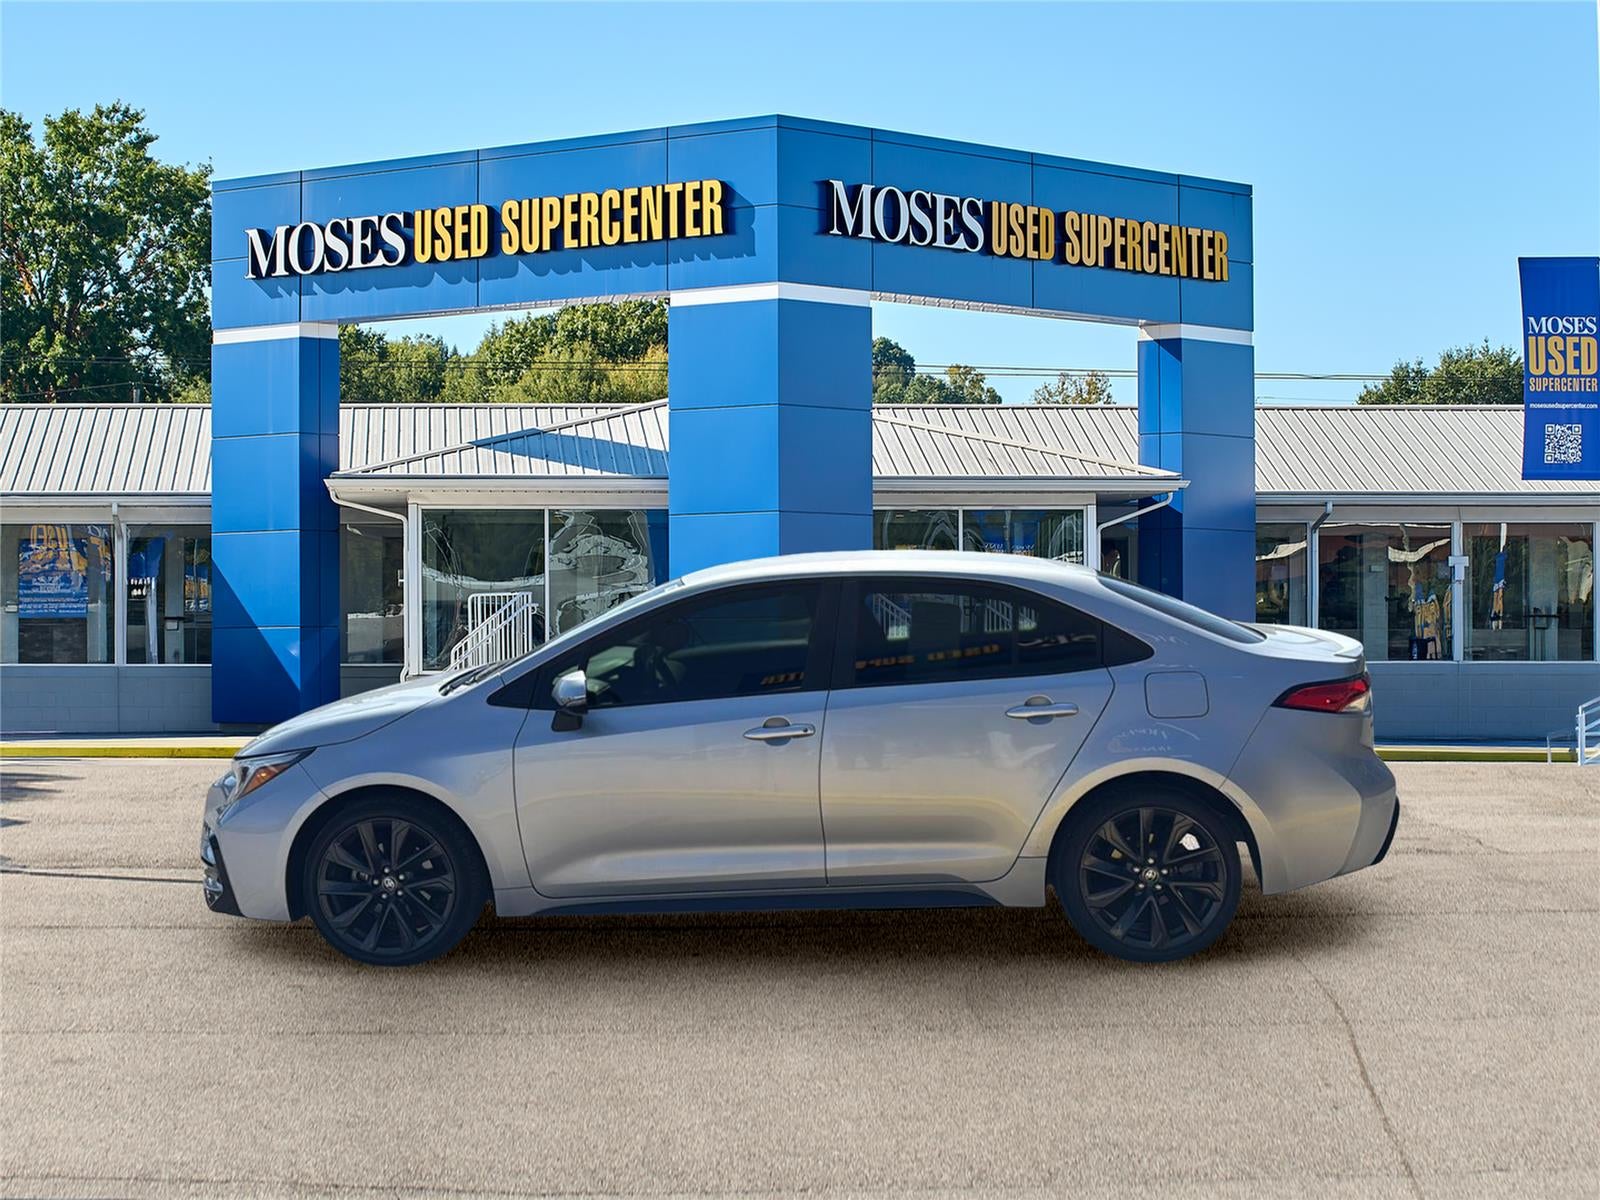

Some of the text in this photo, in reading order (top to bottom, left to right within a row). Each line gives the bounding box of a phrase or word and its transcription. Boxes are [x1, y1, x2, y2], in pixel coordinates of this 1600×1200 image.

[244, 179, 724, 279] MOSES USED SUPERCENTER
[829, 179, 1229, 281] MOSES USED SUPERCENTER
[1528, 316, 1597, 334] MOSES
[1528, 336, 1598, 376] USED
[1529, 377, 1598, 392] SUPERCENTER
[1529, 402, 1598, 410] mosesusedsupercenter.com
